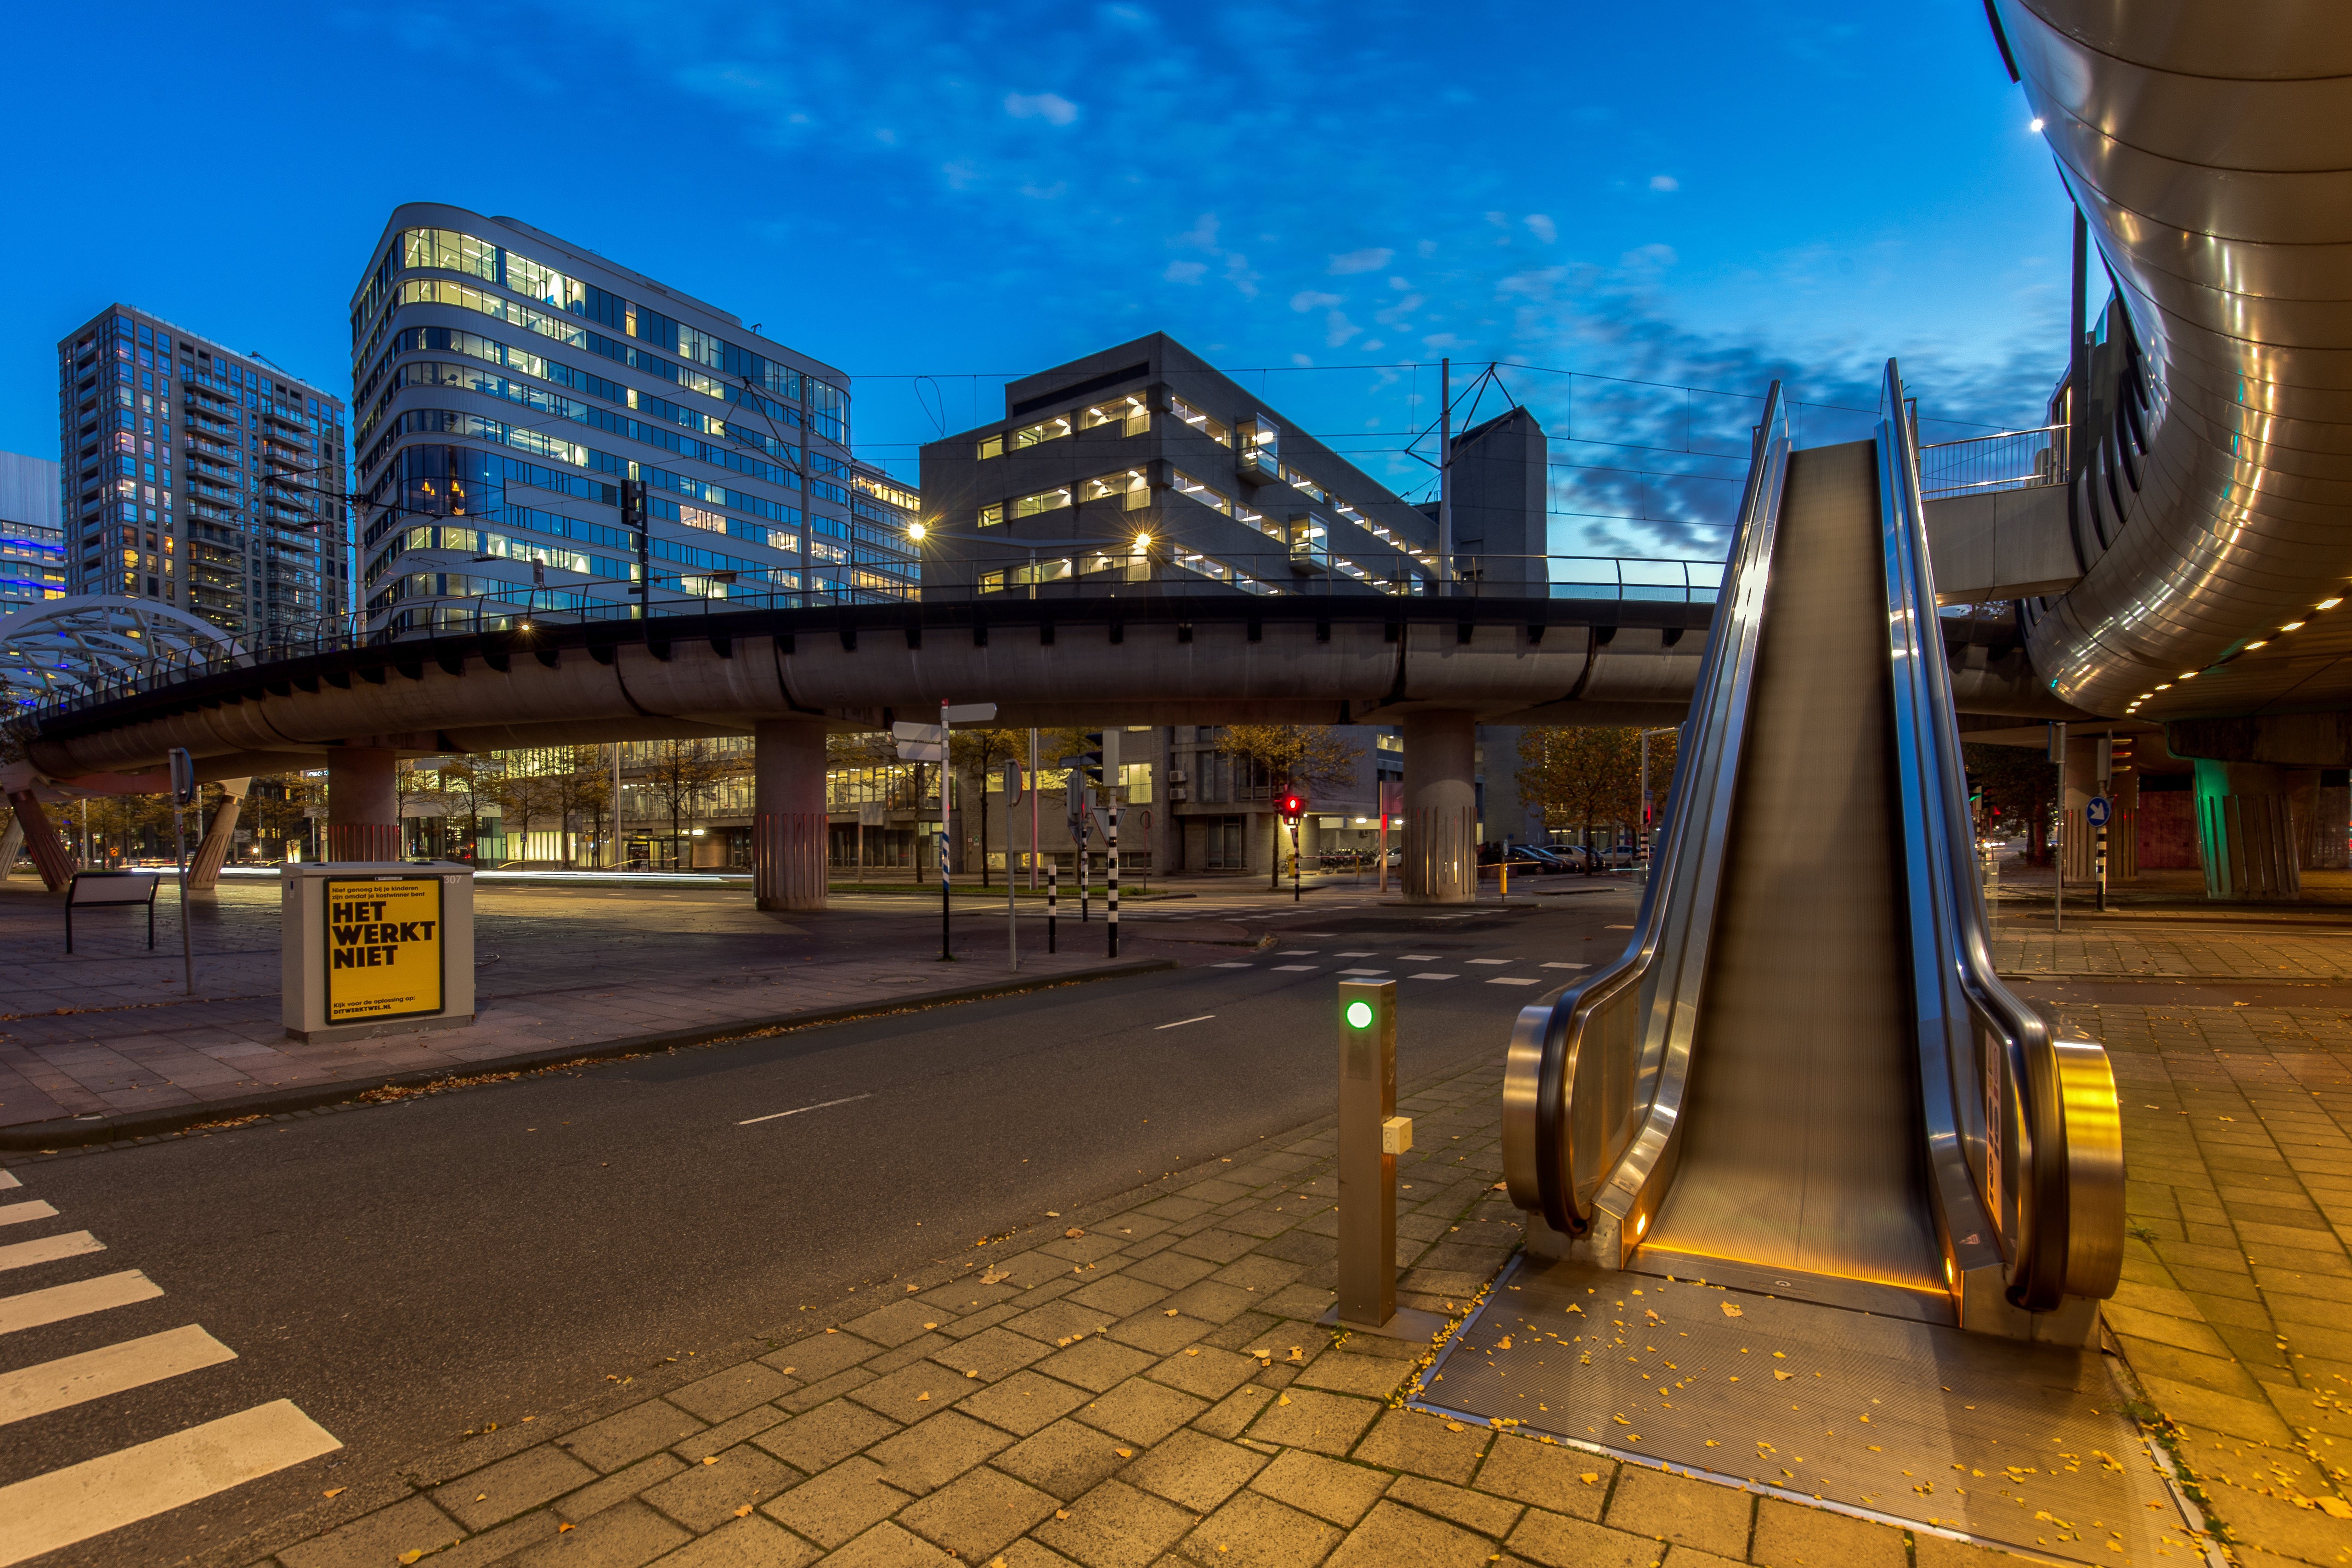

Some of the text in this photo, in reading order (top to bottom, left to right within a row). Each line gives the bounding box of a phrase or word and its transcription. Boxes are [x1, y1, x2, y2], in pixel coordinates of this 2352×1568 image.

[444, 875, 462, 884] 307
[333, 901, 386, 923] HET
[332, 920, 435, 946] WERKT
[334, 944, 398, 969] NIET
[334, 1004, 391, 1015] DITWERKTWEL.NL
